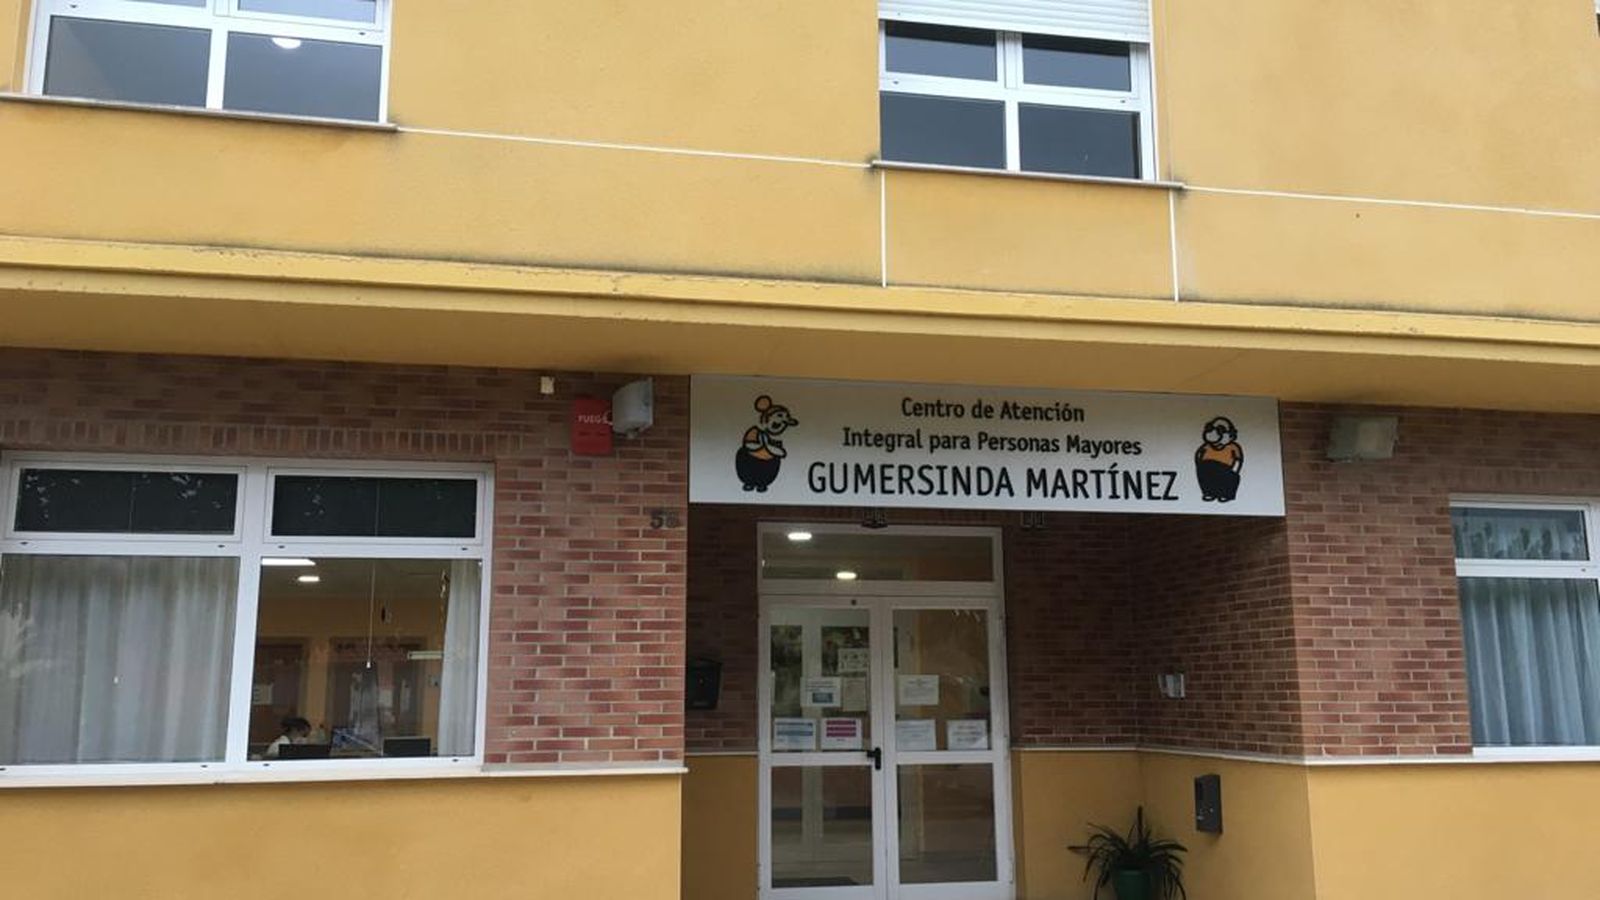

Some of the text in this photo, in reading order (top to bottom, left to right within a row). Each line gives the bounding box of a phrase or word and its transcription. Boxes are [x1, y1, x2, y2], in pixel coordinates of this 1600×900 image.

[901, 396, 1085, 423] Centro de Atención
[842, 426, 1142, 459] Integral para Personas Mayores
[807, 461, 1179, 501] GUMERSINDA MARTÍNEZ
